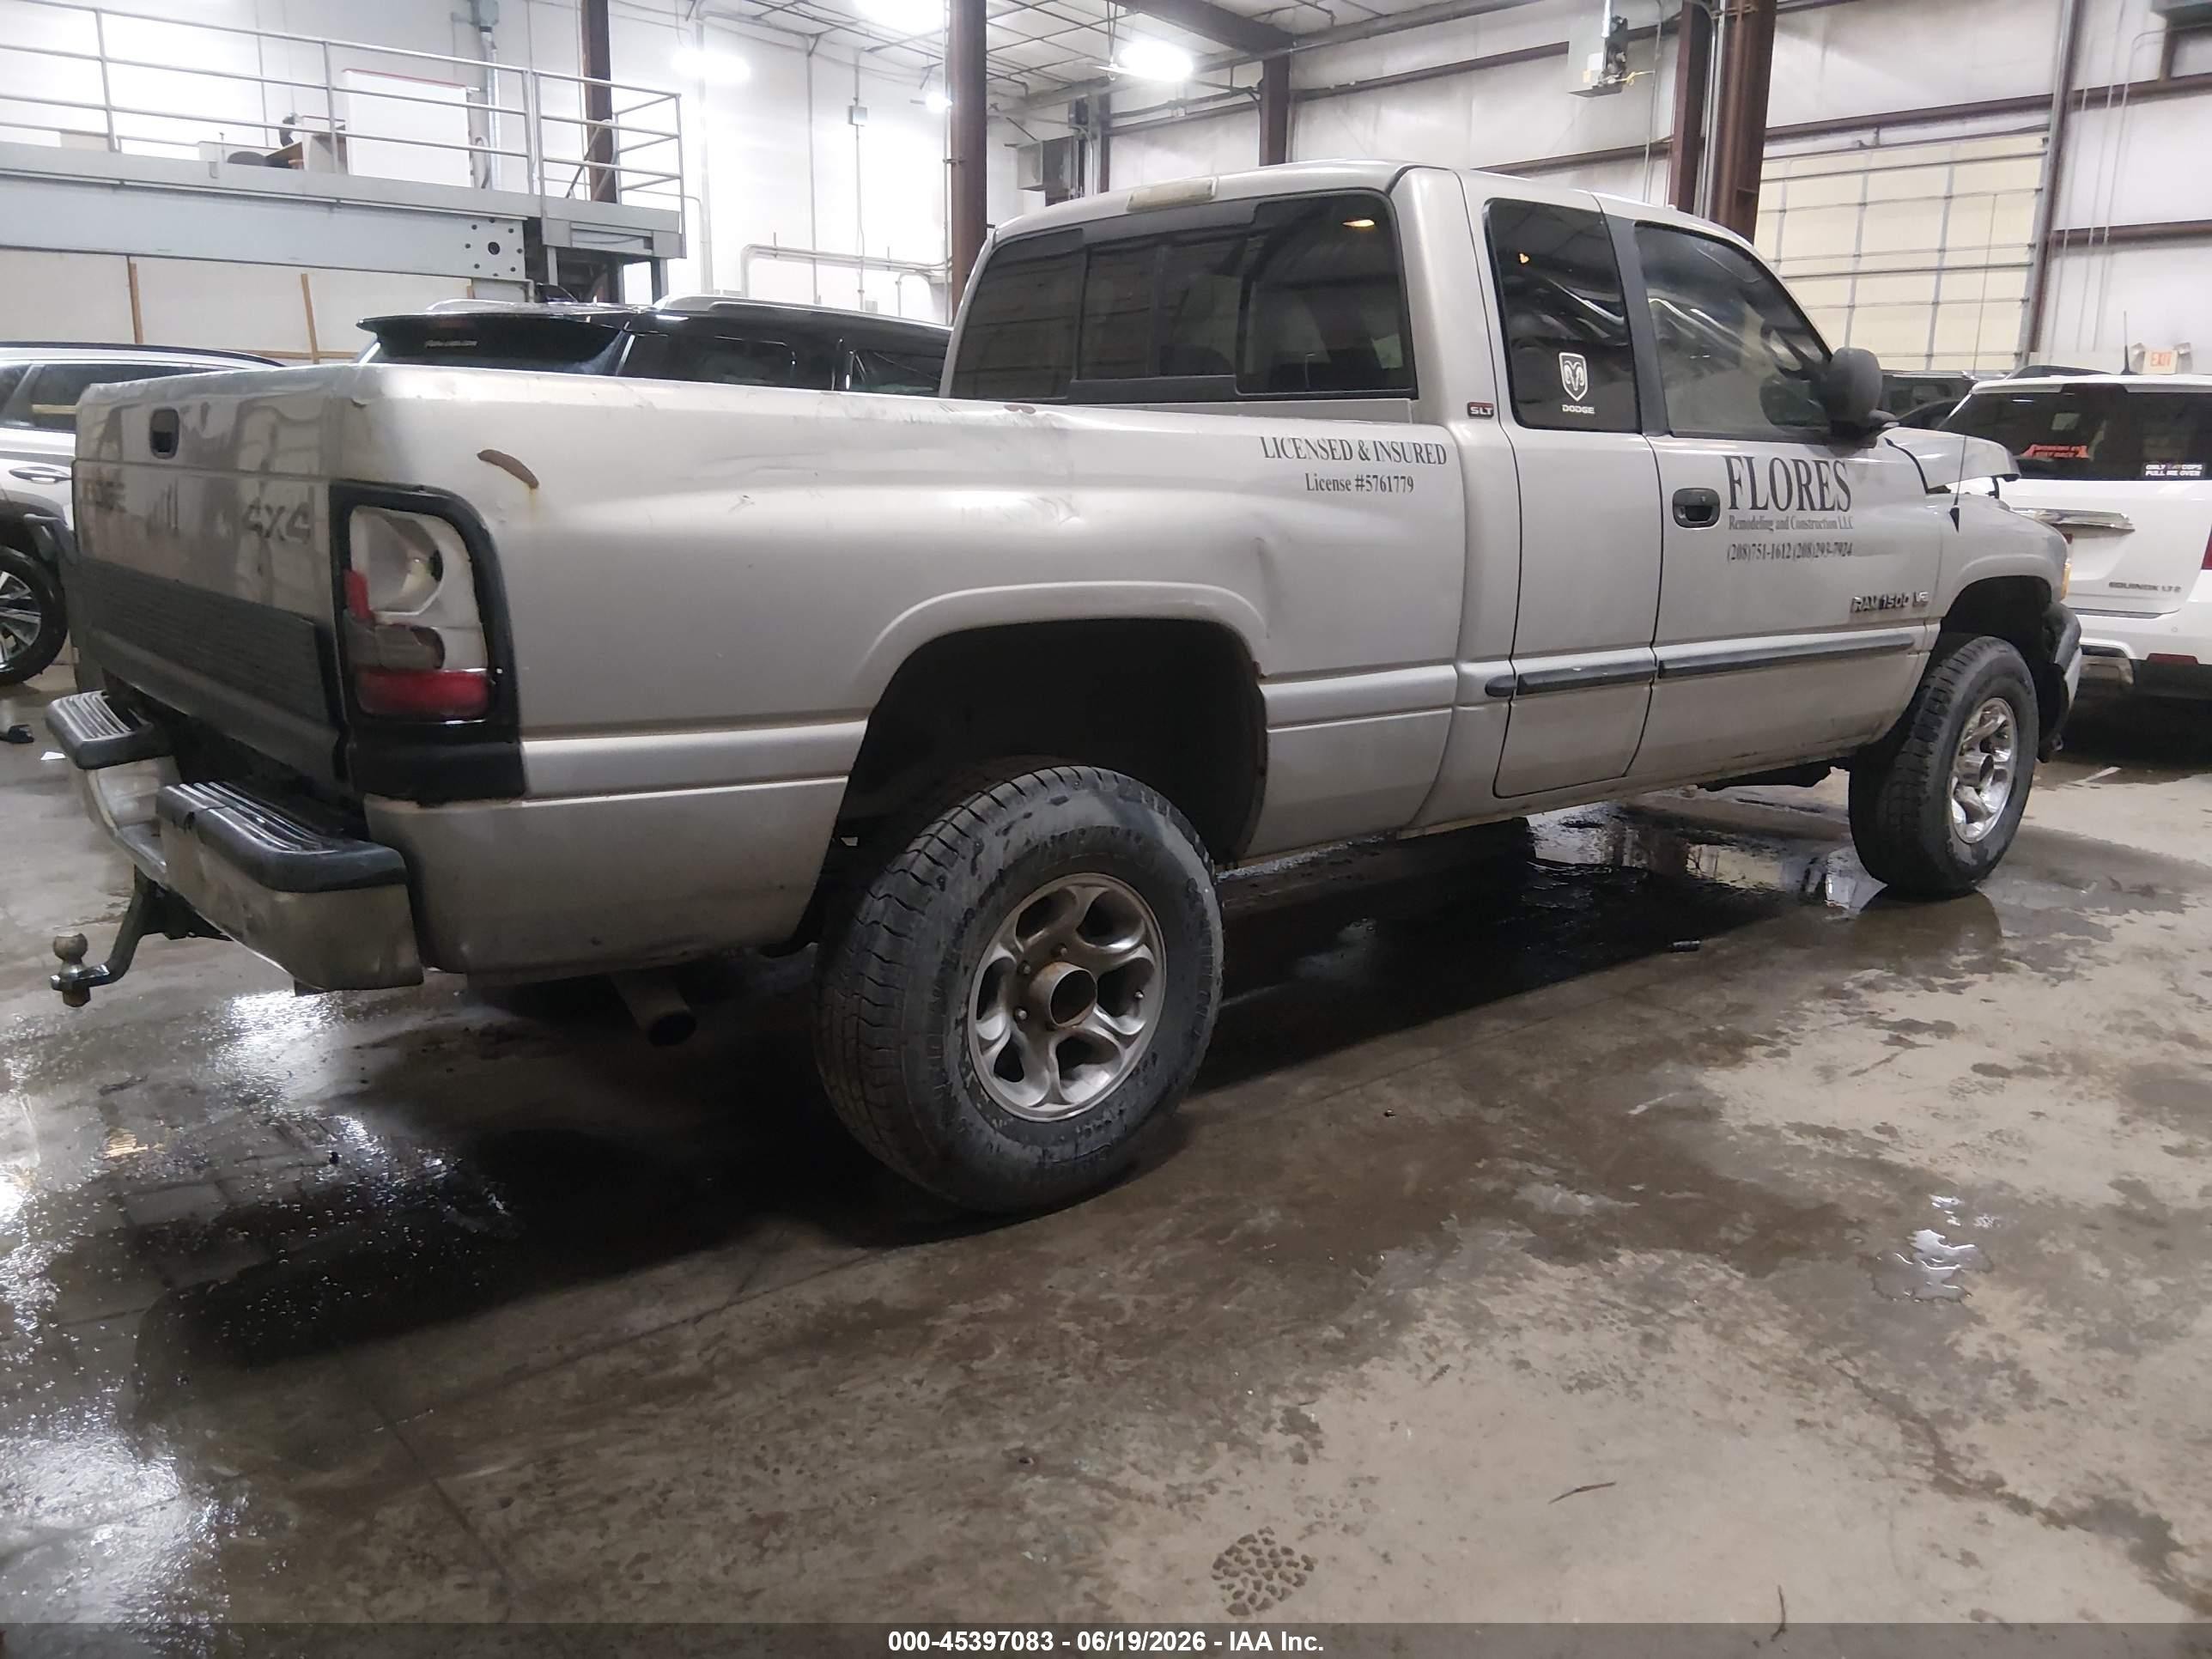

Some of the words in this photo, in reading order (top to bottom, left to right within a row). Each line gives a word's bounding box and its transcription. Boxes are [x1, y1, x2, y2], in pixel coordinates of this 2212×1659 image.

[1470, 406, 1492, 416] SLT
[1562, 404, 1595, 414] DODGE
[1260, 436, 1353, 461] LICENSED
[1358, 443, 1370, 461] &
[1373, 440, 1447, 465] INSURED
[1304, 472, 1352, 491] License
[1354, 474, 1414, 493] #5761779
[1723, 455, 1852, 513] FLORES
[1729, 515, 1774, 532] Remodeling
[1776, 516, 1790, 530] and
[1790, 516, 1838, 530] Construction
[1838, 516, 1853, 529] LLC
[2109, 581, 2158, 591] EQUINOX
[1850, 596, 1877, 613] RAM
[1878, 592, 1909, 610] 1500
